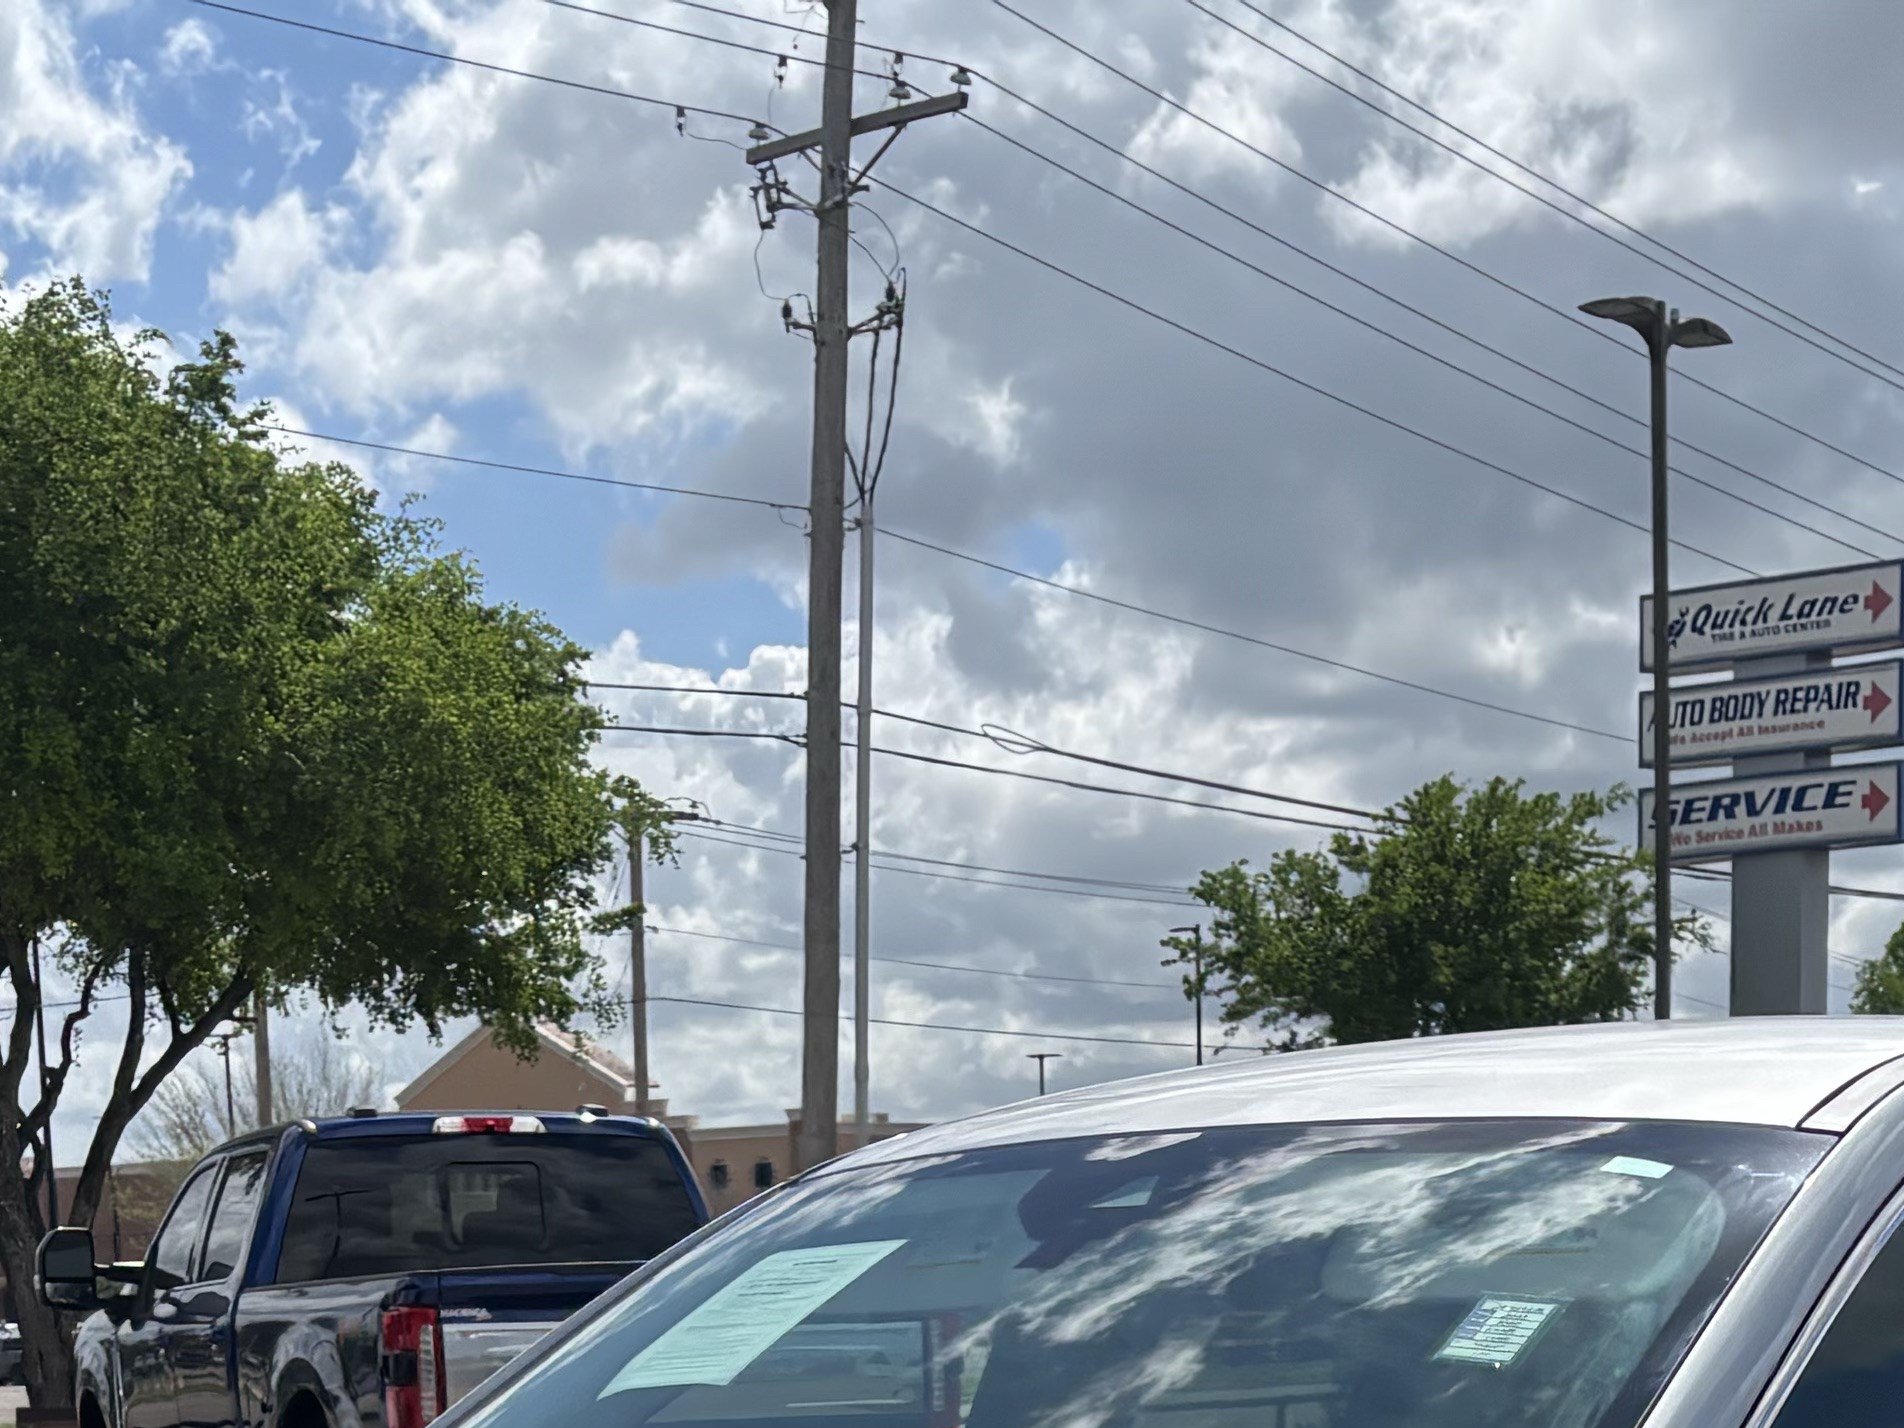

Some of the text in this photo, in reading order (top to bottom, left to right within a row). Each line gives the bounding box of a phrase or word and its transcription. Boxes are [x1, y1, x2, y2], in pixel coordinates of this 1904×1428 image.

[1691, 592, 1859, 635] Quick Lane
[1750, 625, 1781, 638] AUTO
[1784, 618, 1831, 633] CENTER
[1710, 689, 1770, 724] BODY
[1773, 680, 1861, 716] REPAIR
[1695, 827, 1744, 843] Service
[1773, 819, 1823, 835] Makes
